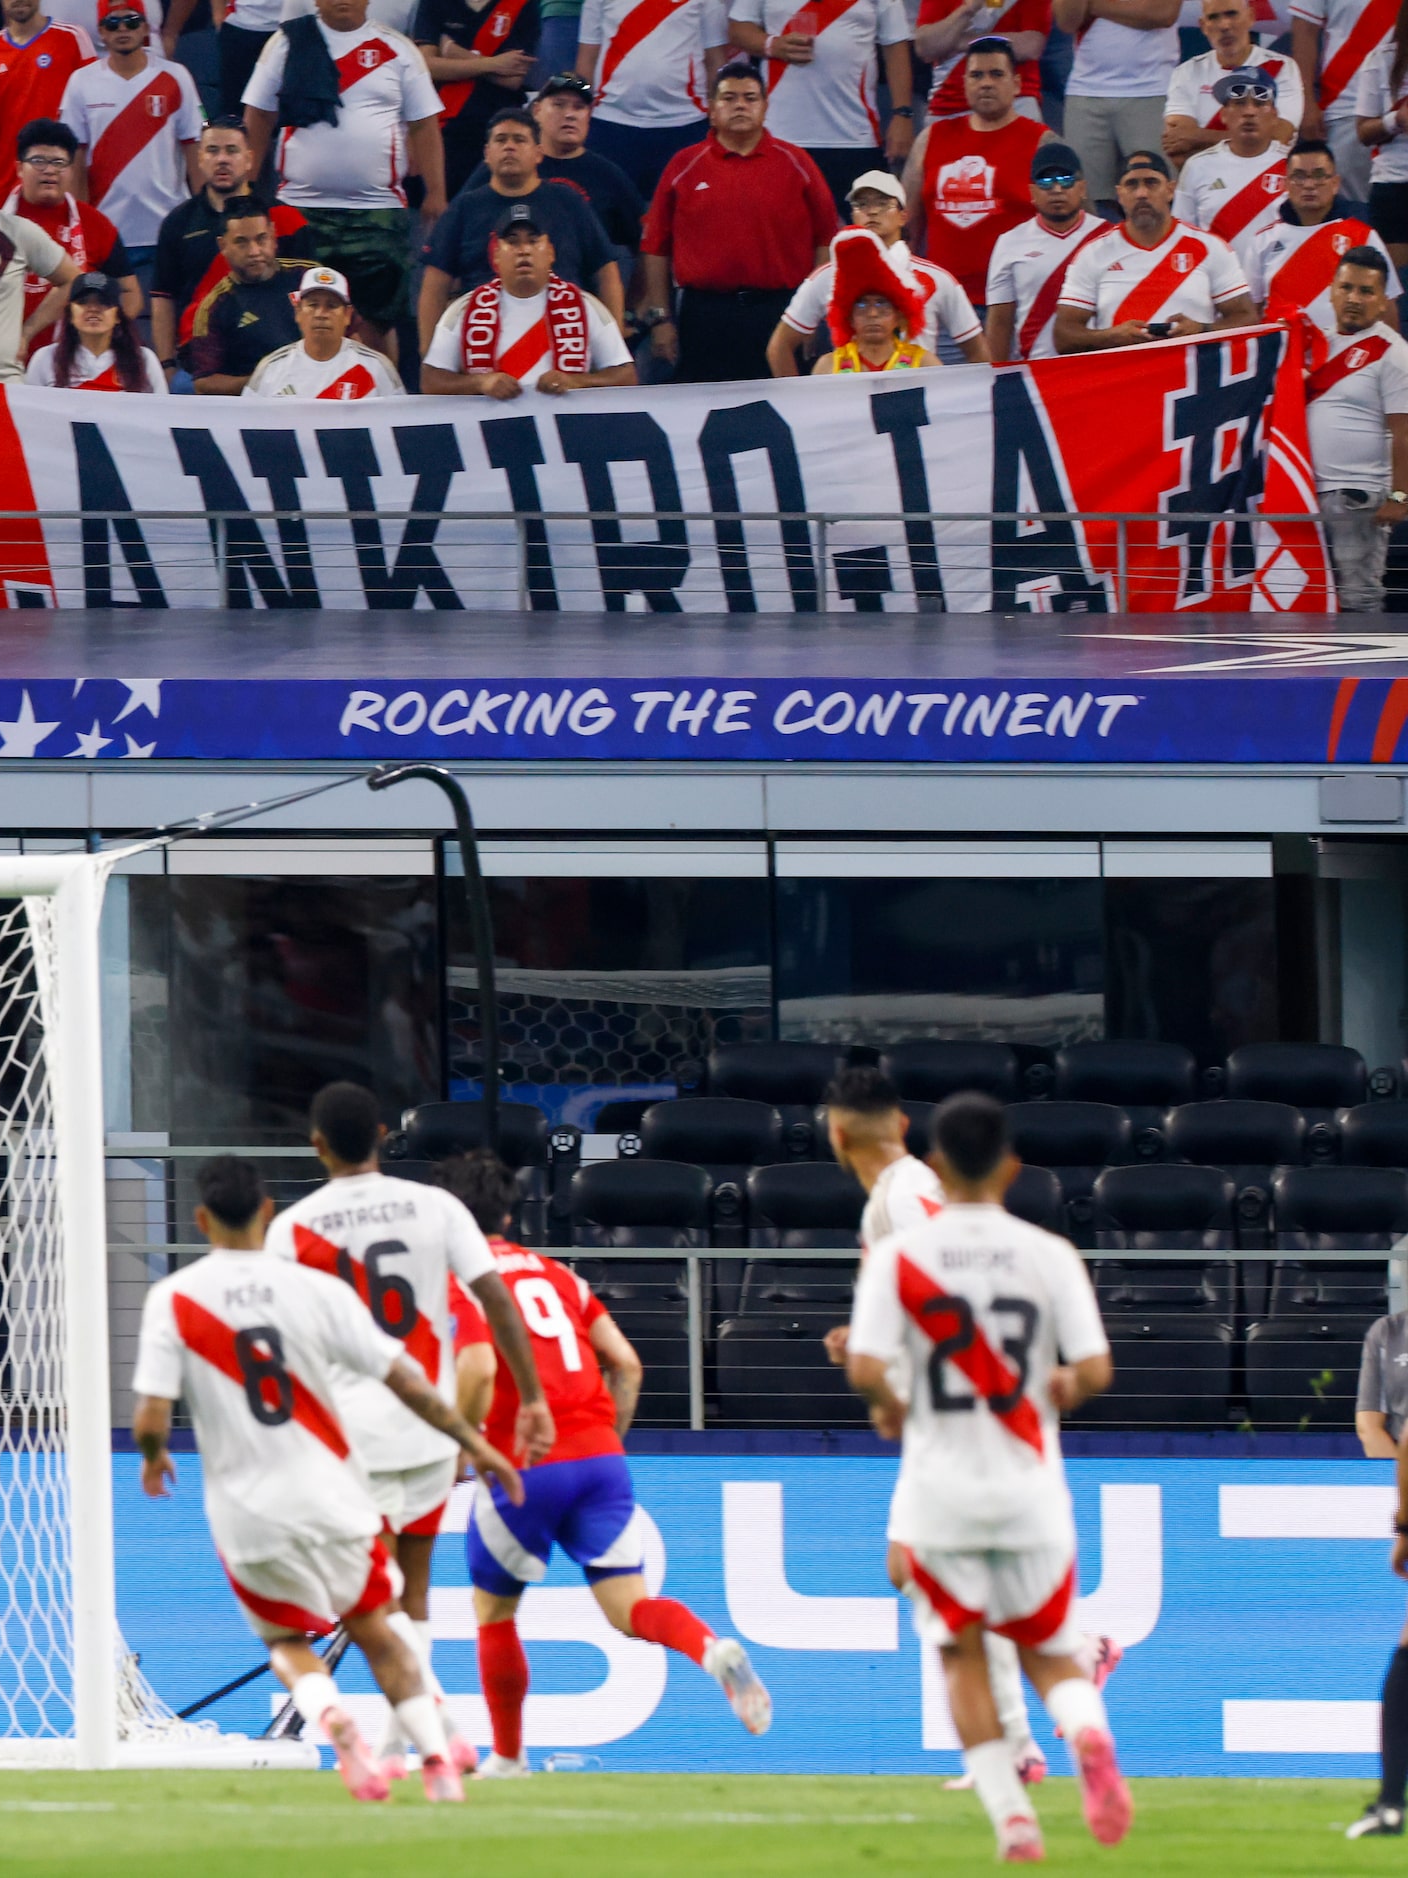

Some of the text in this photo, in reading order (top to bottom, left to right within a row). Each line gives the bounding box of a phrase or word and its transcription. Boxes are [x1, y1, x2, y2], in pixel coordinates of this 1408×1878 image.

[339, 688, 616, 736] ROCKING
[631, 689, 757, 737] THE
[309, 1199, 417, 1233] CARTAGENA
[514, 1277, 583, 1373] 9
[922, 1295, 1039, 1413] 23
[235, 1325, 294, 1426] 8
